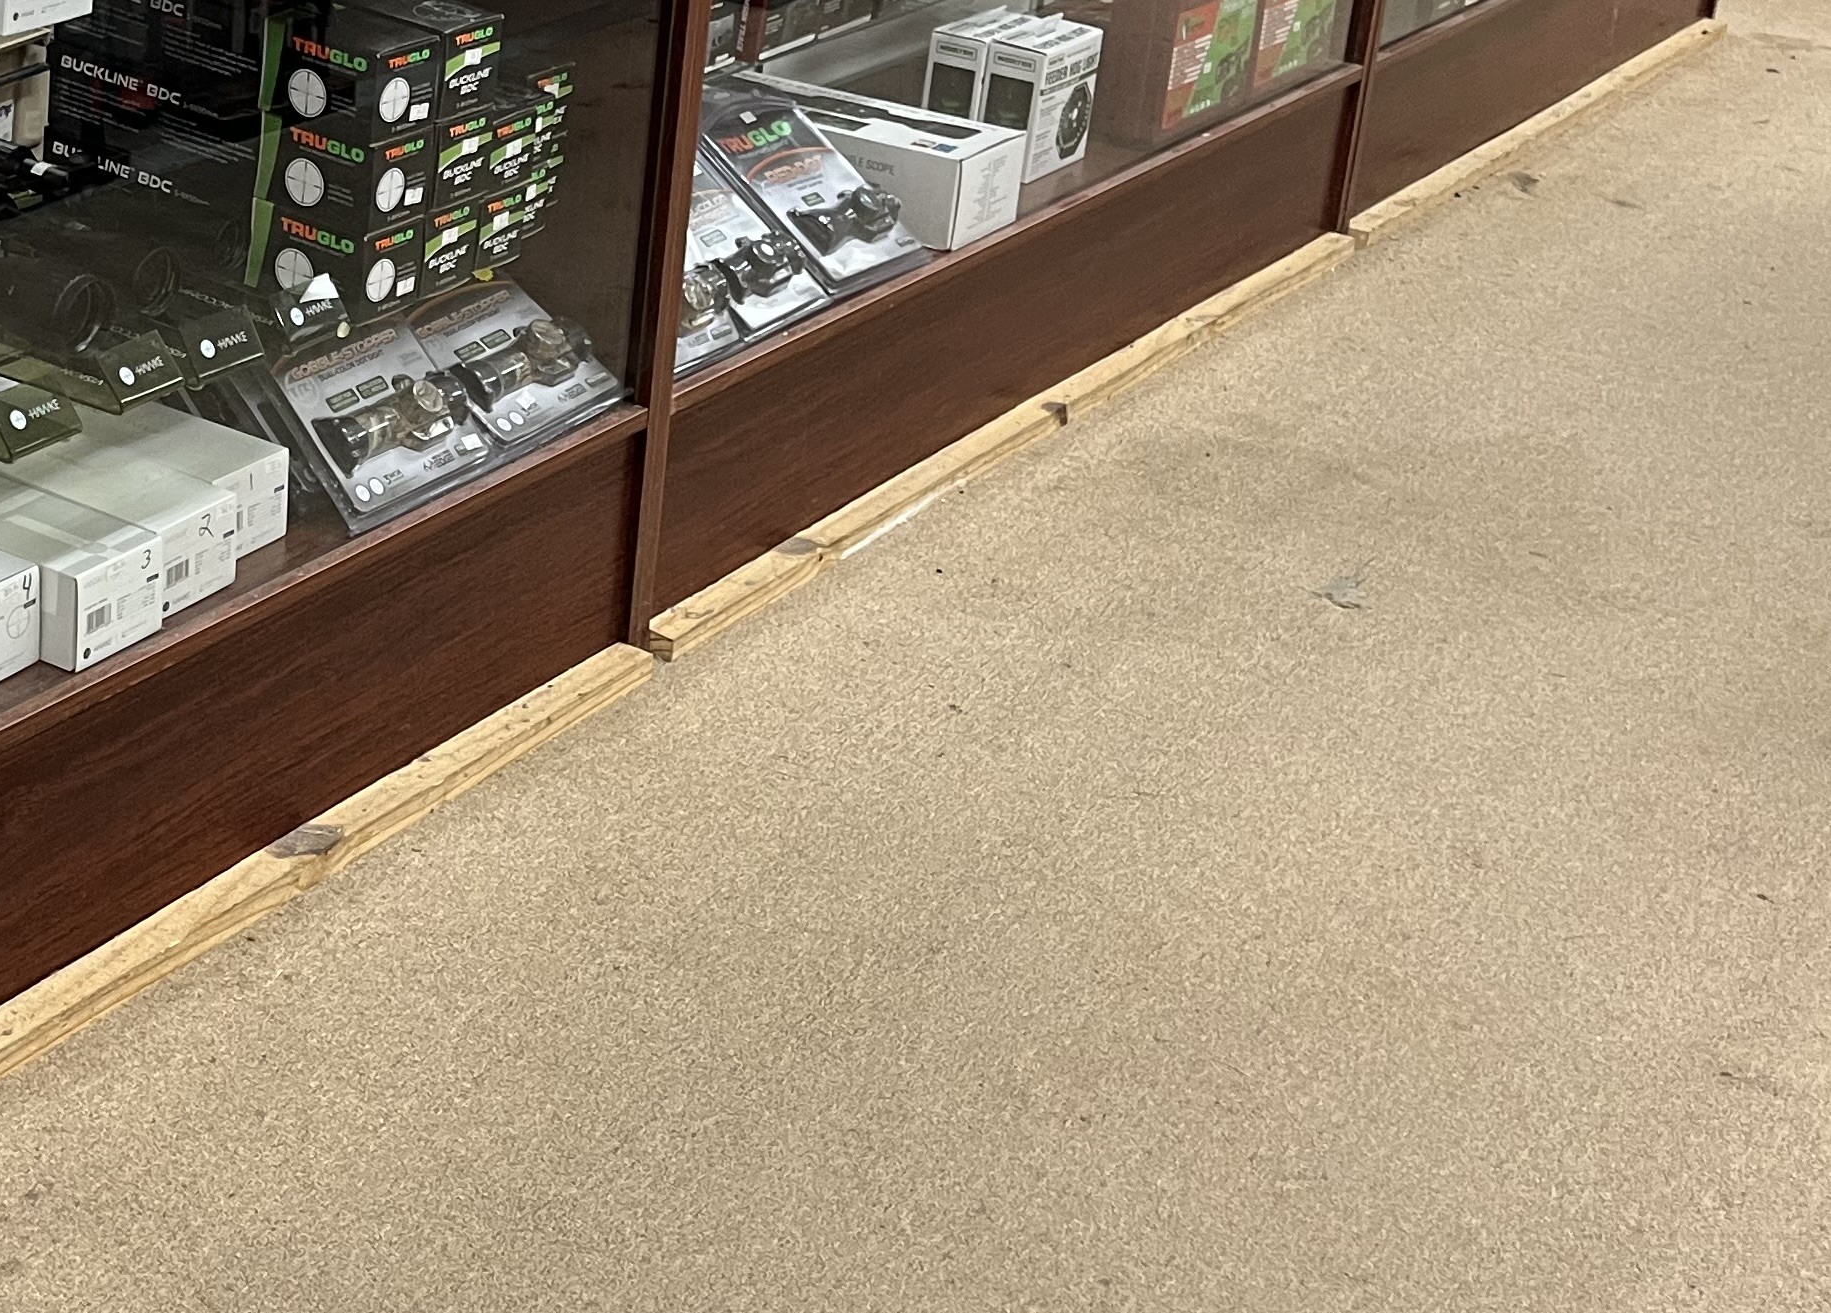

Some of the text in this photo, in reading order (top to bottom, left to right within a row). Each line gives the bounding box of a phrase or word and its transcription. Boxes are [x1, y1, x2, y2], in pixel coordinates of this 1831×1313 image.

[455, 26, 495, 47] TRUGLO
[292, 36, 369, 73] TRUGLO
[387, 47, 432, 71] TRUGLO
[60, 54, 140, 92] BUCKLINE
[146, 83, 182, 106] BDC
[448, 66, 493, 90] BUCKLINE
[535, 100, 555, 116] GLO
[448, 116, 488, 139] TRUGLO
[496, 116, 533, 139] TRUGLO
[720, 120, 793, 155] TRUGLO
[289, 126, 366, 164] TRUGLO
[384, 138, 426, 162] TRUGLO
[52, 140, 133, 179] BULINE
[136, 170, 174, 195] BDC
[442, 156, 486, 181] BUCKLINE
[865, 159, 895, 176] SCOPE
[486, 194, 523, 214] TRUGLO
[433, 205, 471, 229] TRUGLO
[280, 215, 356, 255] TRUGLO
[374, 228, 415, 252] TRUGLO
[428, 244, 470, 270] BUCKLINE
[304, 297, 334, 318] HAWKE
[216, 330, 249, 350] HAWKE
[134, 355, 165, 377] HAWKE
[28, 398, 61, 420] HAWKE
[198, 513, 215, 538] 2
[140, 548, 152, 570] 3
[22, 573, 33, 601] 4
